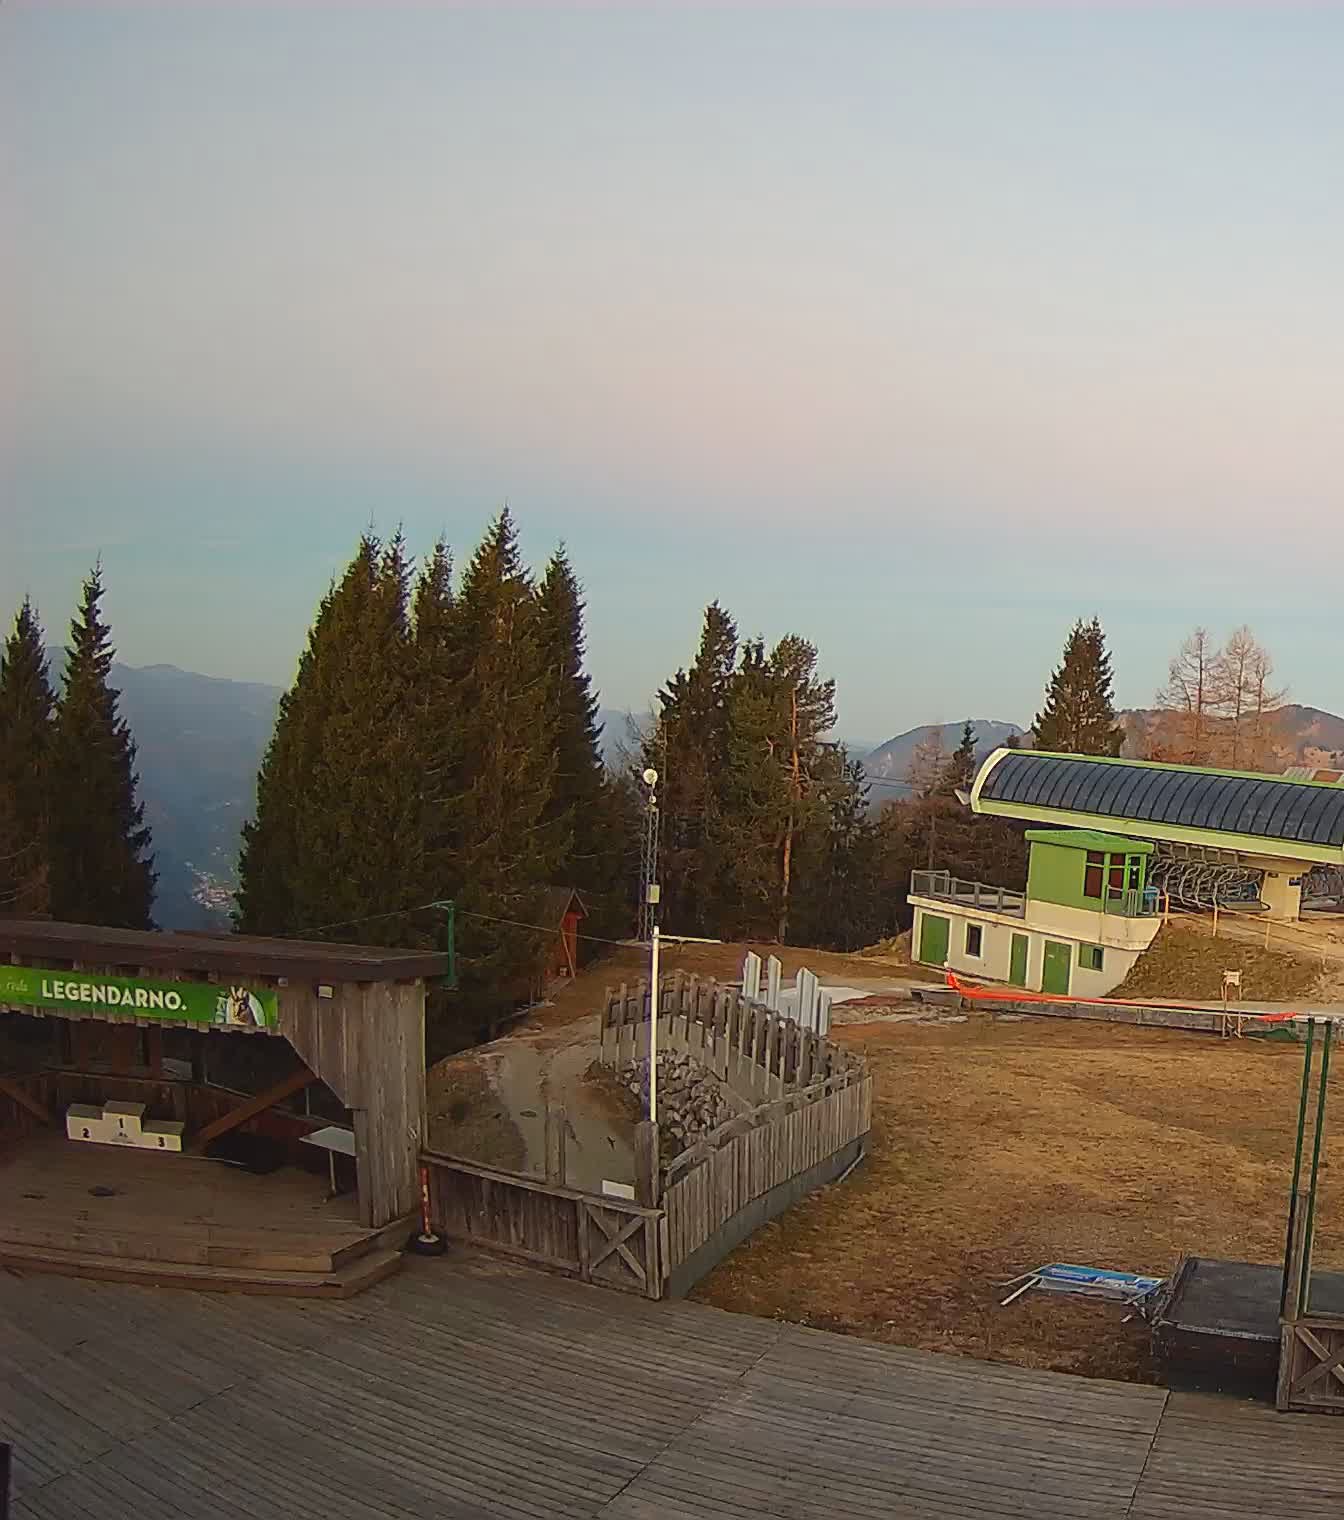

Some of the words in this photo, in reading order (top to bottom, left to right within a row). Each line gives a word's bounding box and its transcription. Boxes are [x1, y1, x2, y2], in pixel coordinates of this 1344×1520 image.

[41, 979, 188, 1012] LEGENDARNO.
[119, 1117, 124, 1129] 1
[82, 1127, 90, 1139] 2
[158, 1136, 166, 1148] 3
